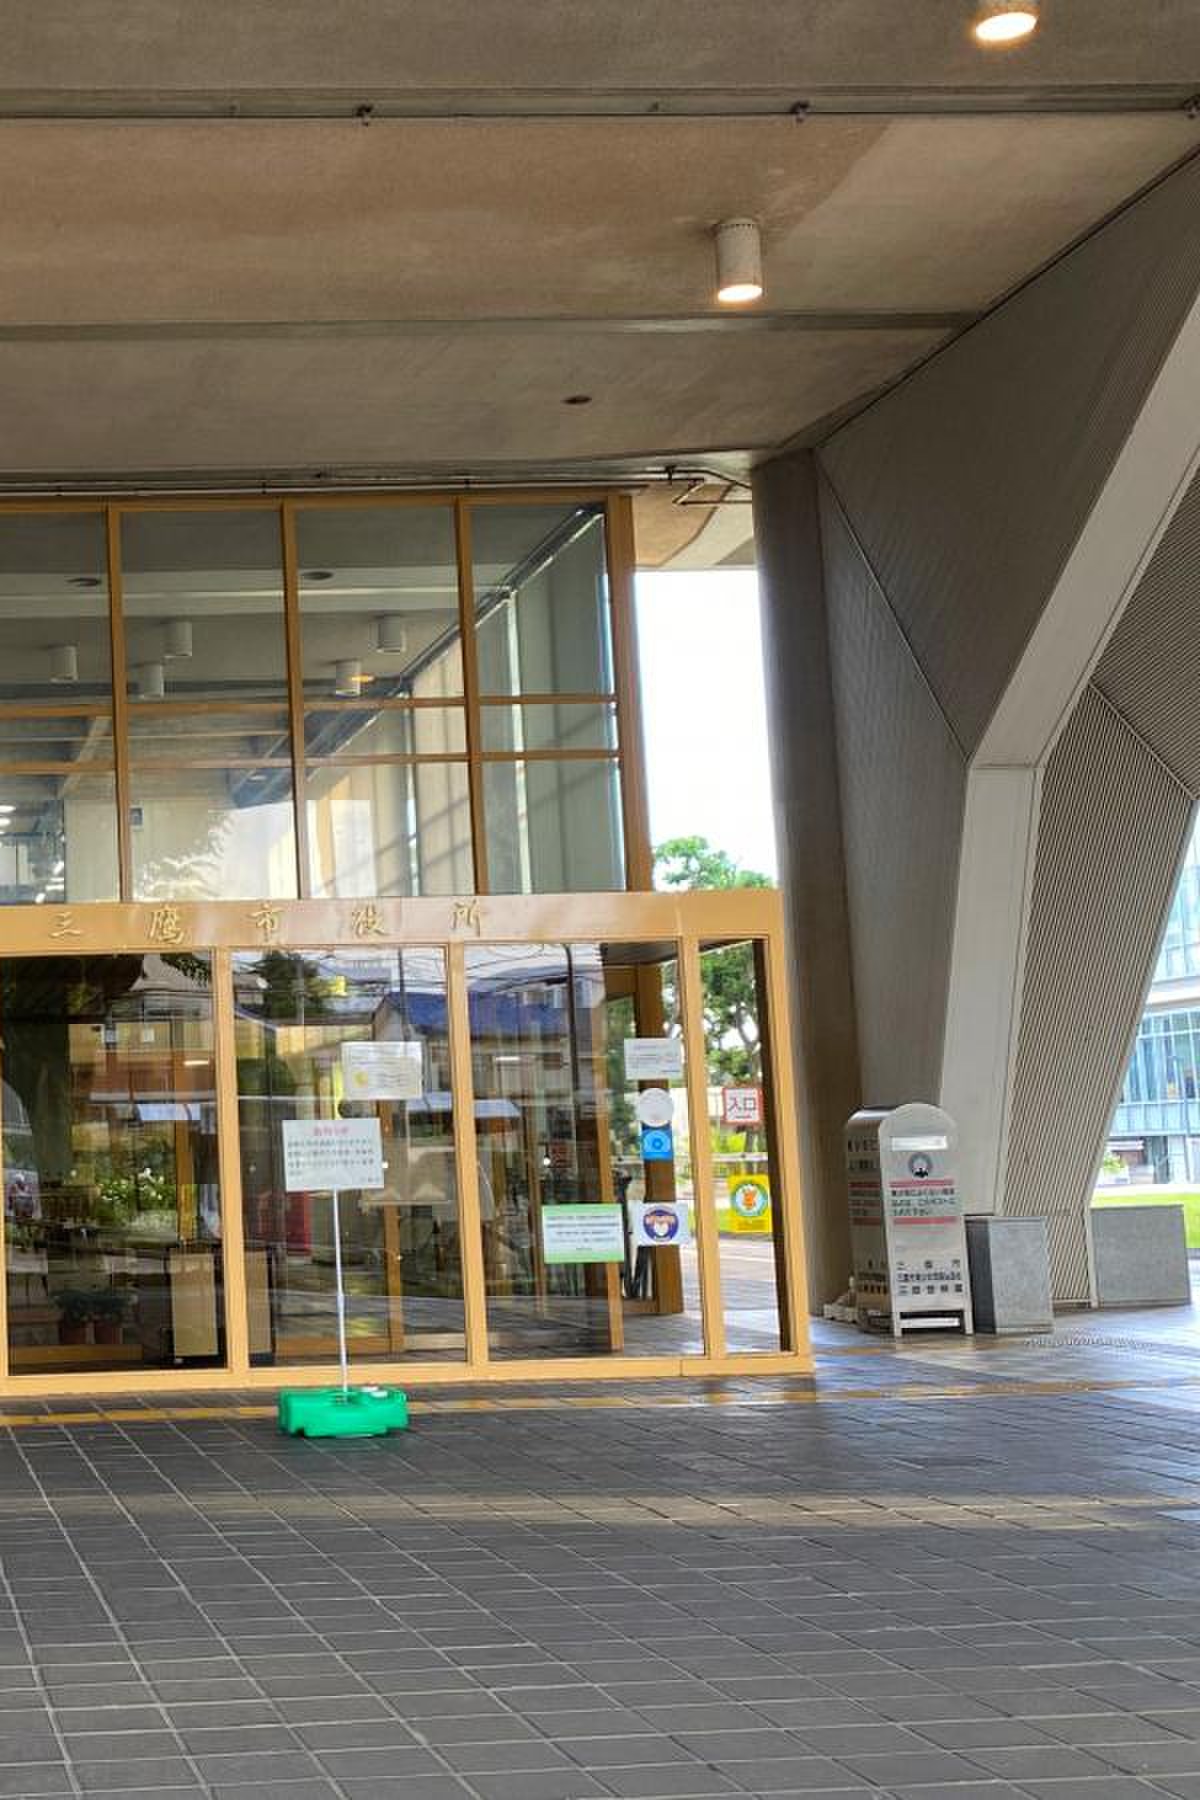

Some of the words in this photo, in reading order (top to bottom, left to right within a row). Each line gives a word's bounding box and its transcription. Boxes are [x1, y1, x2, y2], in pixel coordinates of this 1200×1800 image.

[49, 900, 483, 943] 三鷹市役所
[728, 1097, 756, 1111] 入口
